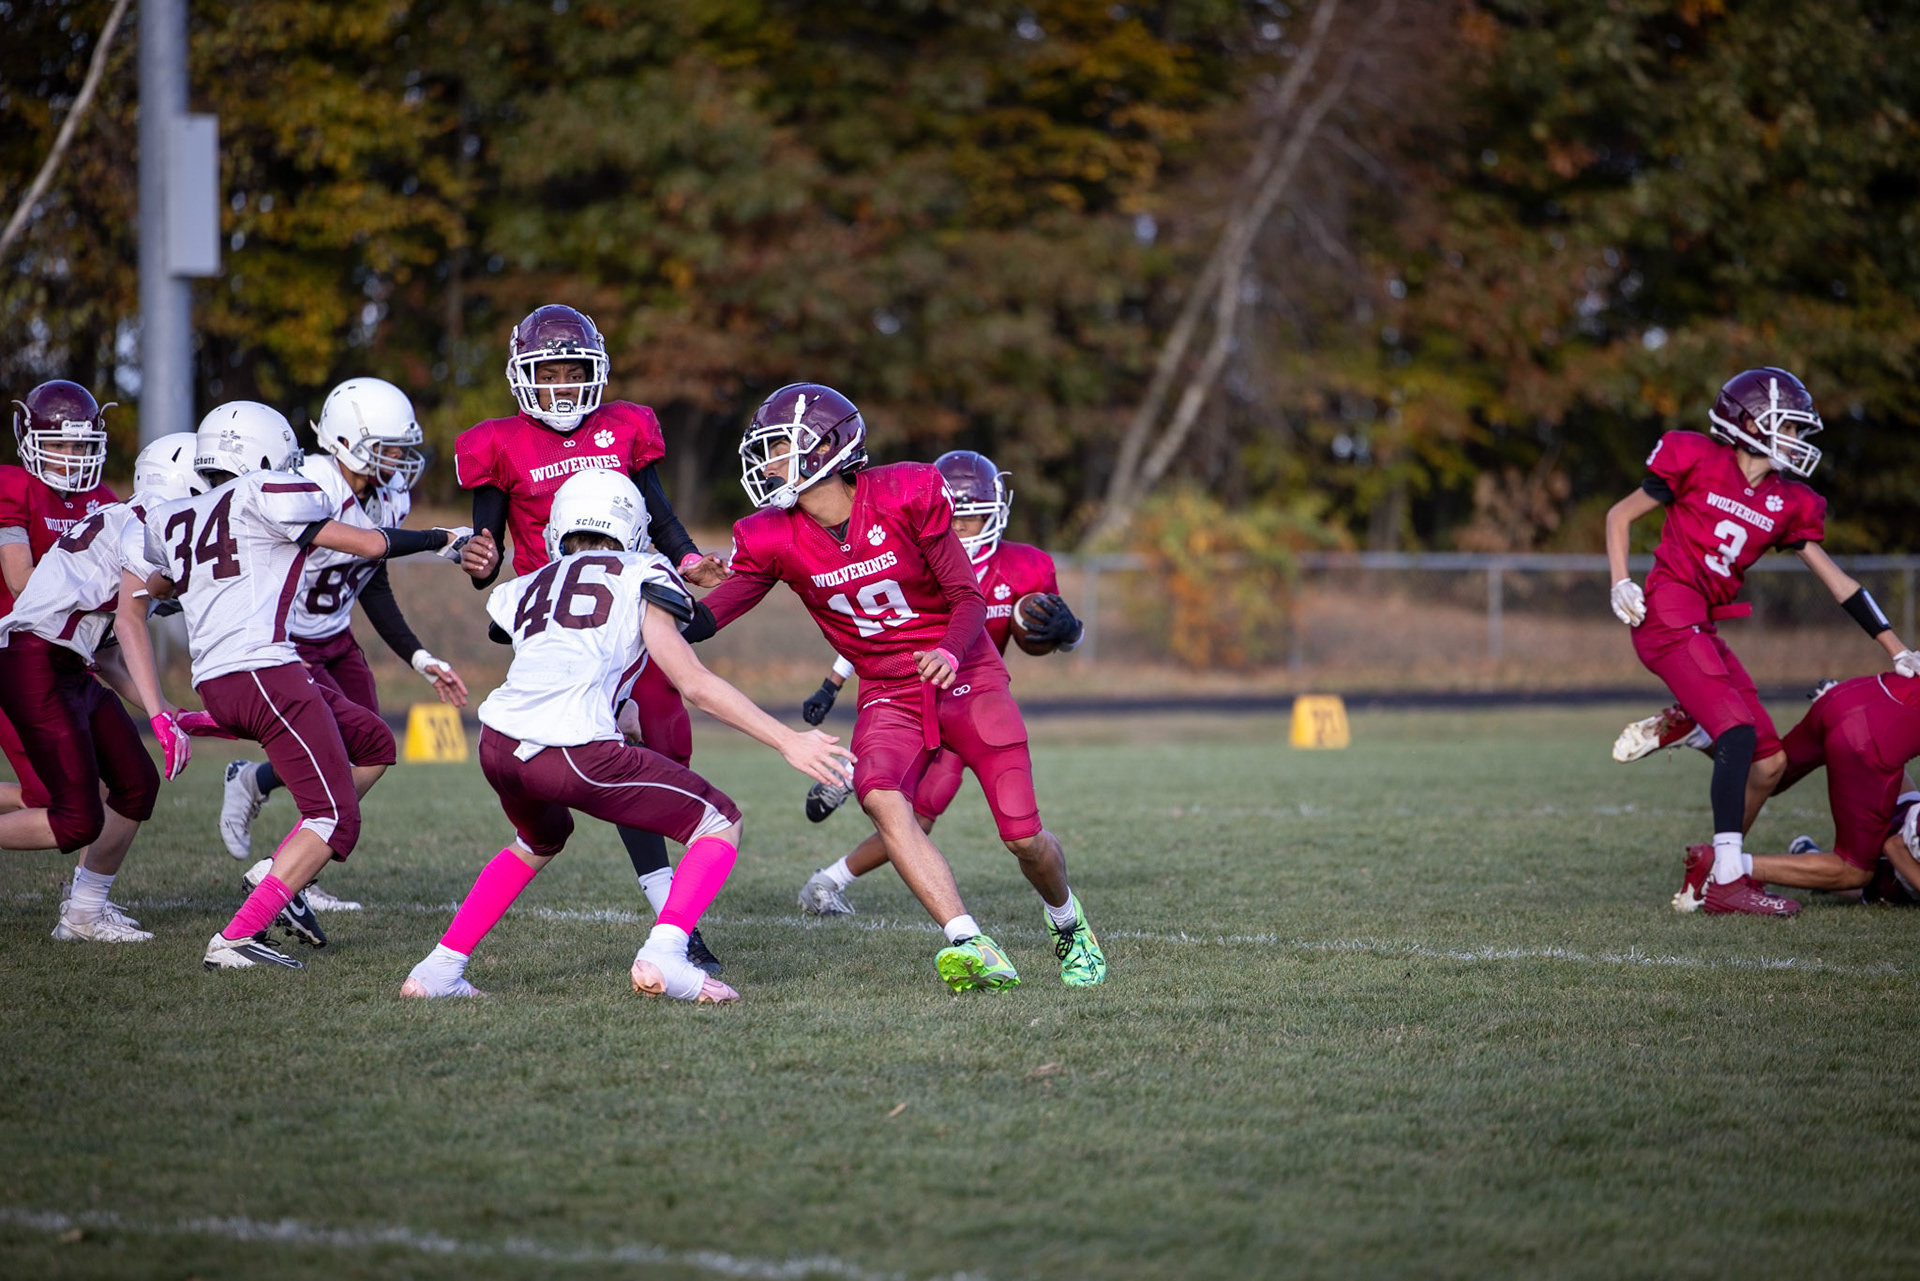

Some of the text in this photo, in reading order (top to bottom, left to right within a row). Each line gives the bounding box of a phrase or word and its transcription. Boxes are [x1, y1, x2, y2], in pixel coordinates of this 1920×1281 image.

[530, 454, 622, 483] WOLVERINES
[575, 517, 612, 529] schutt
[1706, 491, 1775, 533] WOLVERINES
[165, 488, 241, 598] 34
[1704, 519, 1749, 578] 3
[811, 551, 898, 588] WOLVERINES
[514, 556, 624, 640] 46
[827, 579, 920, 638] 19
